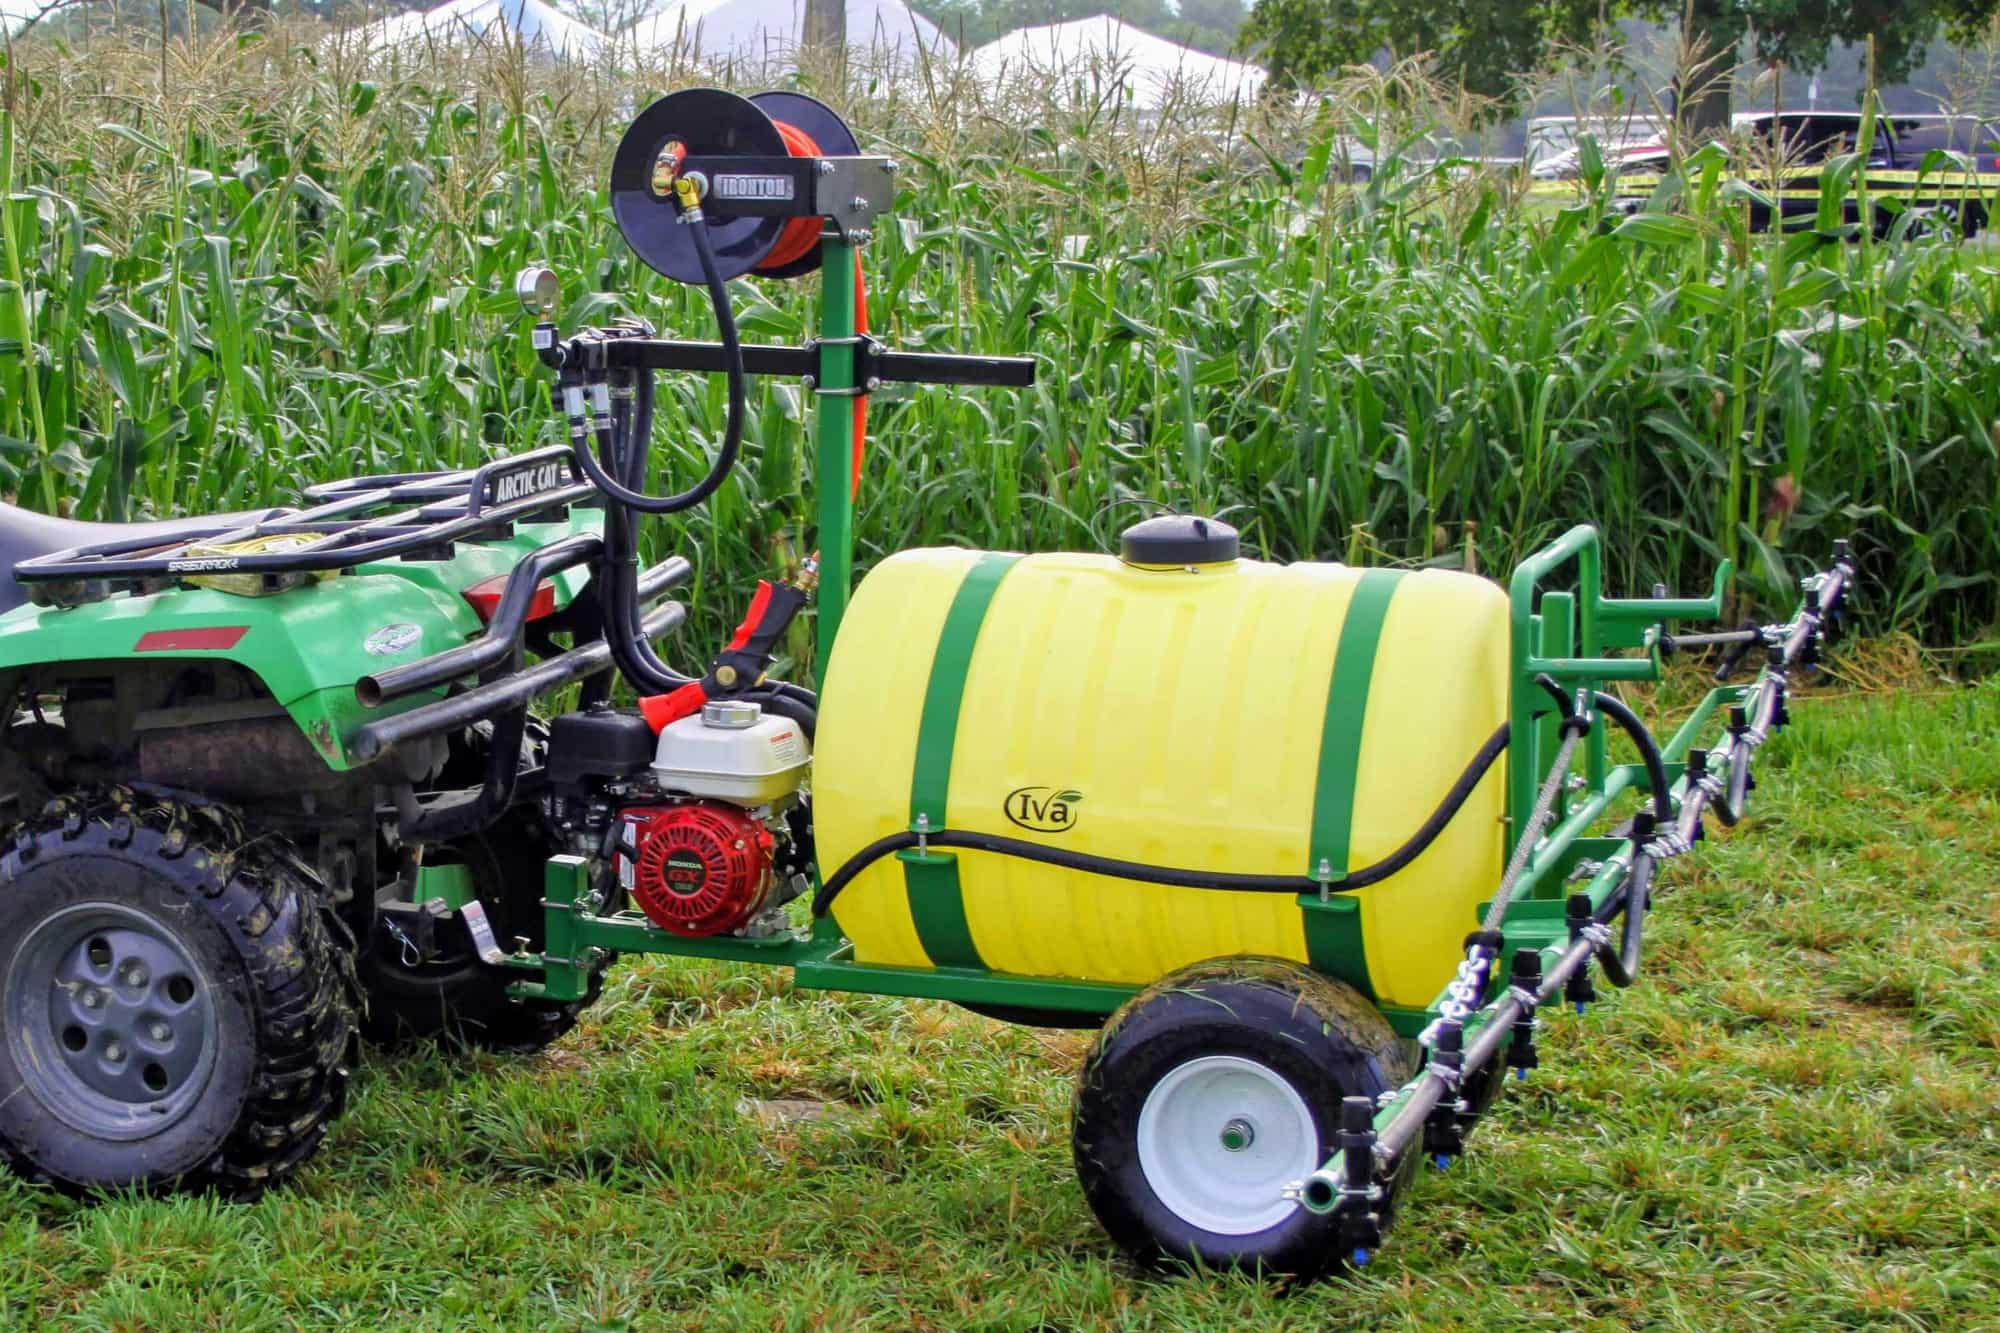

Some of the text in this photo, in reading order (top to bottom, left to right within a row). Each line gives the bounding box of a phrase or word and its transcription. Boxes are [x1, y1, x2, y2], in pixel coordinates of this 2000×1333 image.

[722, 177, 785, 196] IRONTON
[496, 463, 558, 503] ARCTIC CAT
[1018, 789, 1068, 824] Iva
[667, 860, 704, 869] HONDA
